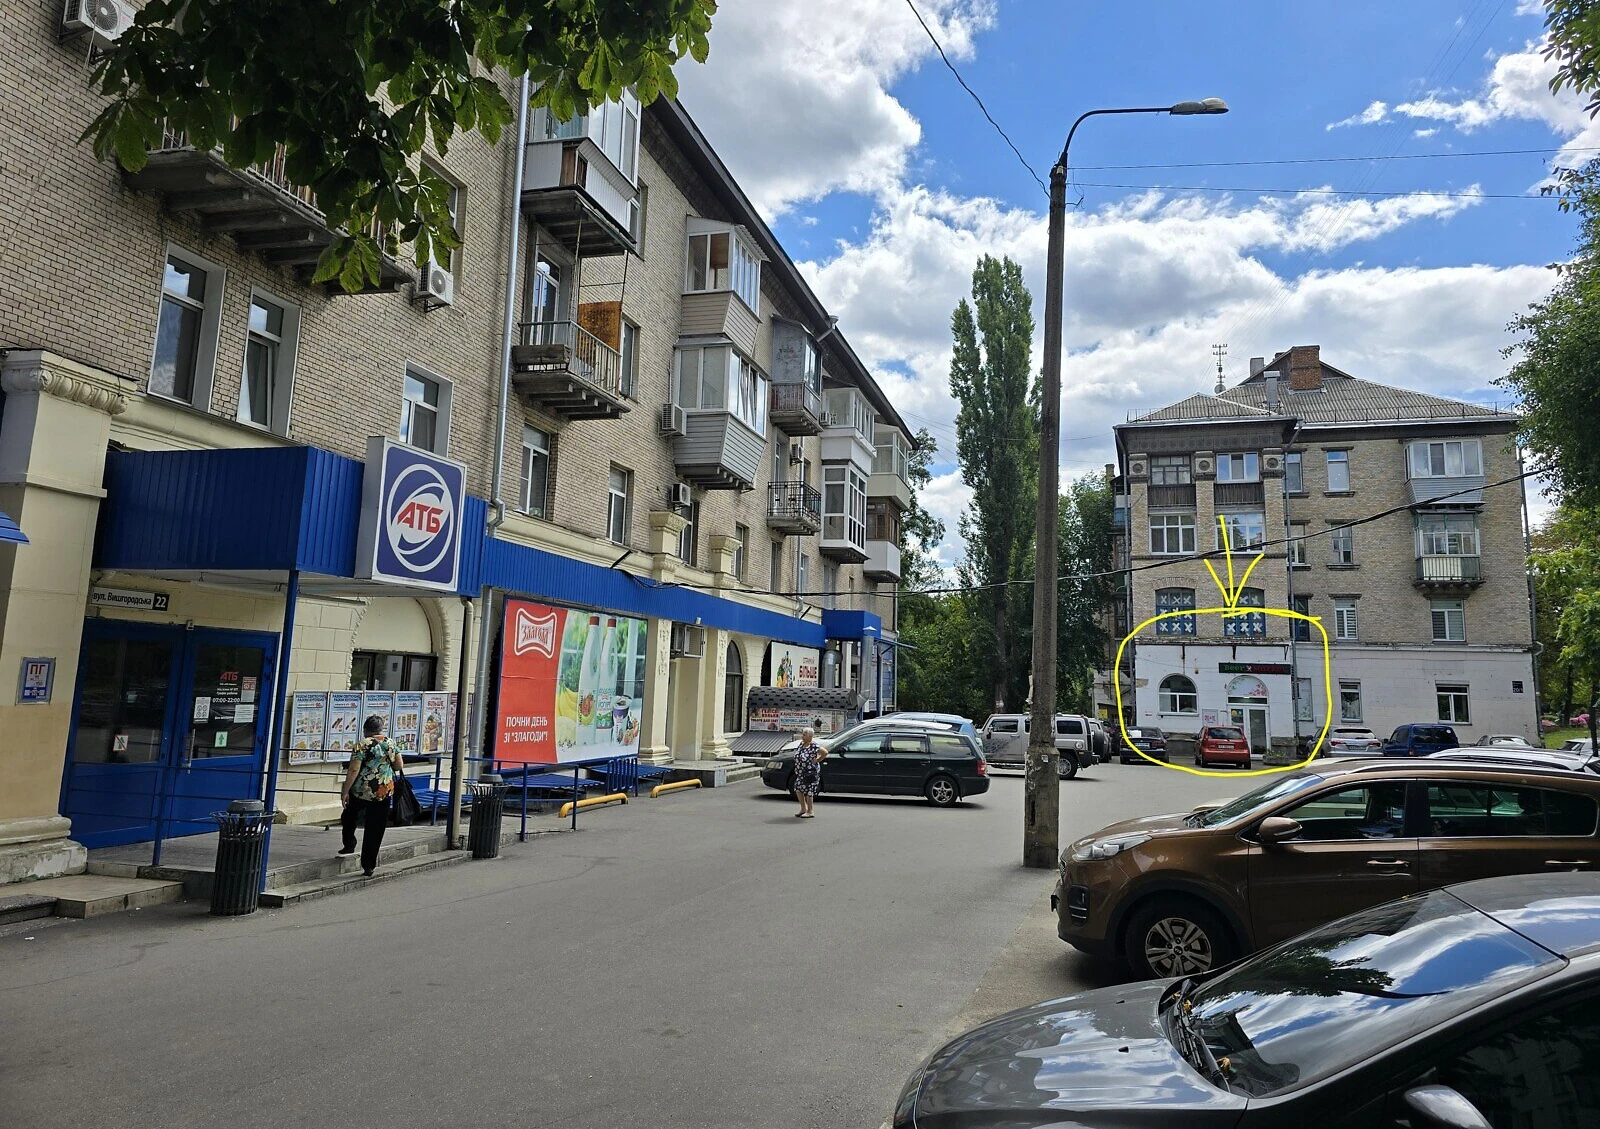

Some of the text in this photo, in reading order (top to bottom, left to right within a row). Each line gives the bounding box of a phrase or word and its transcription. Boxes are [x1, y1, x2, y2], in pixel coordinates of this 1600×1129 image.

[397, 501, 444, 534] АТБ
[92, 592, 167, 608] вул. Вишгородська 22
[30, 664, 46, 675] ПГ
[220, 671, 239, 681] АТБ
[505, 716, 548, 728] ПОЧНИ ДЕНЬ
[503, 733, 511, 744] ЗІ
